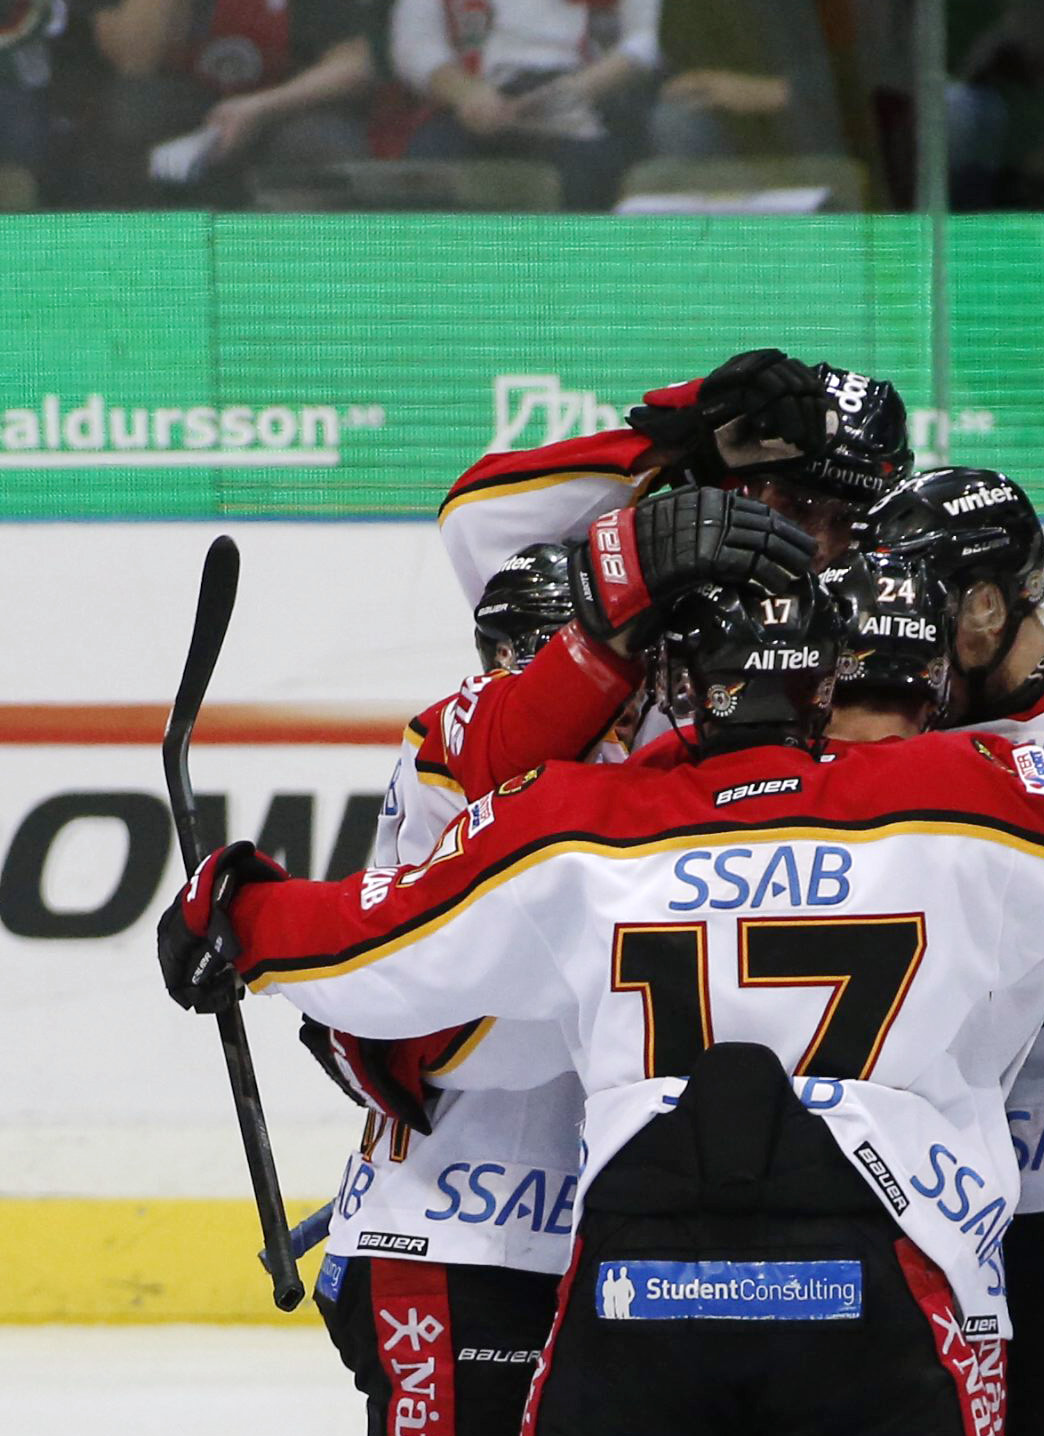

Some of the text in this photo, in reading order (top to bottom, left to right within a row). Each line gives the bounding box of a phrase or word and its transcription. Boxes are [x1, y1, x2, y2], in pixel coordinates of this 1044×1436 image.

[1, 395, 341, 450] aldursson
[877, 577, 916, 604] 24
[760, 599, 792, 626] 17
[861, 616, 937, 643] All Tele
[744, 646, 820, 671] All Tele
[715, 778, 800, 806] BAUER
[668, 845, 853, 911] SSAB
[611, 912, 928, 1081] 17
[857, 1147, 909, 1213] BAUER
[358, 1233, 426, 1252] BAUER
[458, 1348, 541, 1364] BAUER
